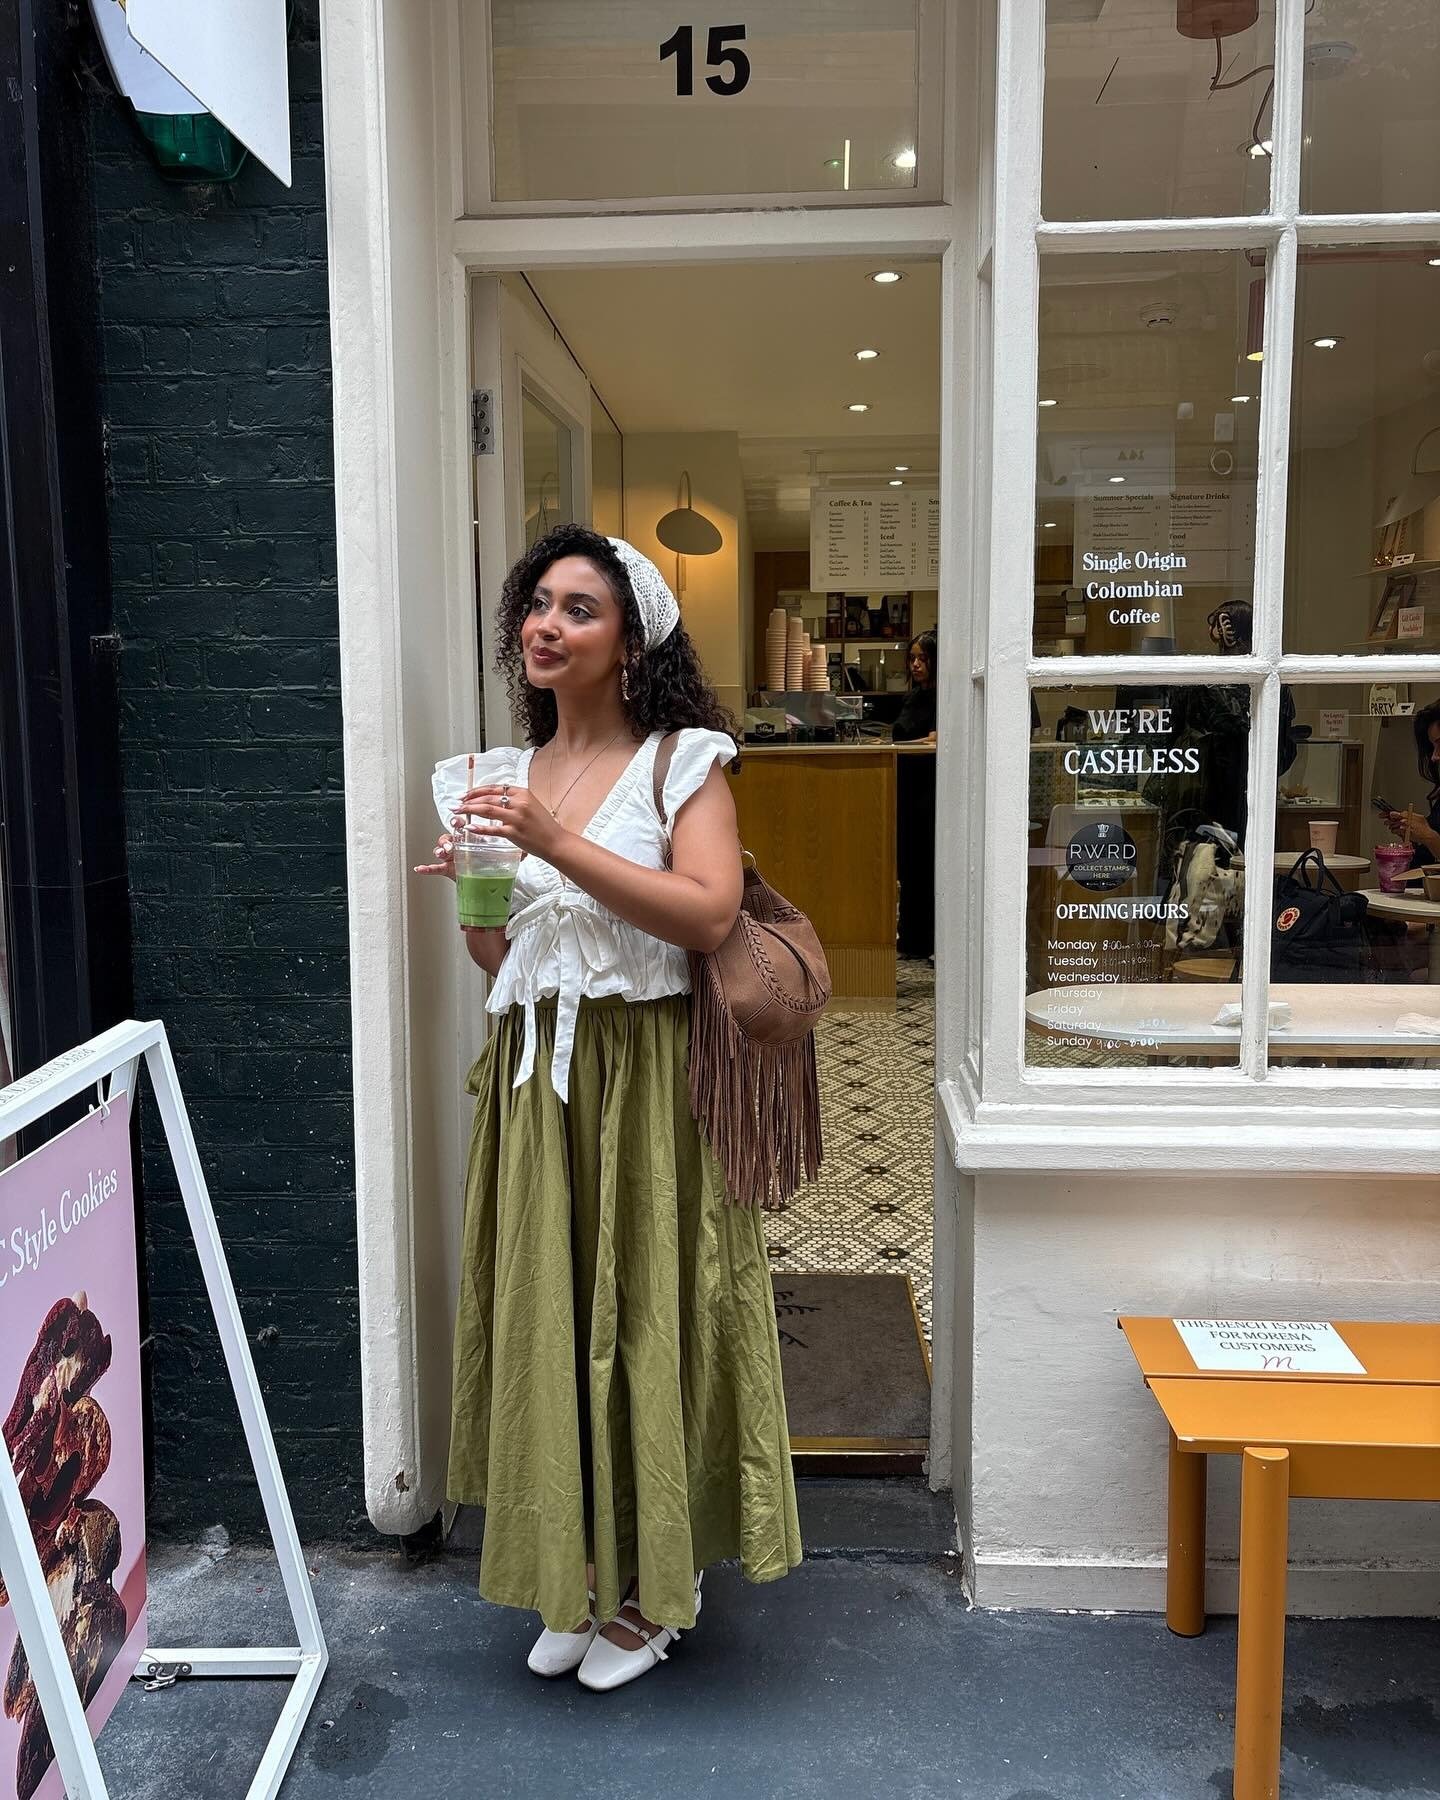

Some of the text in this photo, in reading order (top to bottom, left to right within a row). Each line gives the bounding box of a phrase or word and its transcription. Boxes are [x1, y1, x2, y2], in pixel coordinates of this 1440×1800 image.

[659, 24, 751, 96] 15
[828, 499, 852, 507] Coffee
[1083, 552, 1132, 574] Single
[1134, 550, 1188, 571] Origin
[1086, 580, 1184, 599] Colombian
[1109, 609, 1161, 624] Coffee
[1371, 702, 1395, 715] PARTY
[1088, 709, 1173, 734] WE'RE
[1064, 749, 1200, 774] CASHLESS
[1070, 843, 1136, 859] RWRD
[1056, 903, 1189, 919] OPENING HOURS
[1047, 939, 1097, 952] Monday
[1047, 955, 1099, 968] Tuesday
[1047, 971, 1120, 984] Wednesday
[1047, 987, 1103, 1000] Thursday
[1047, 1003, 1084, 1016] Friday
[1047, 1019, 1102, 1032] Saturday
[1047, 1035, 1093, 1048] Sunday
[10, 1207, 57, 1276] Style
[60, 1169, 118, 1234] Cookies
[1177, 1320, 1329, 1331] THIS BENCH IS ONLY
[1210, 1331, 1313, 1341] FOR MORENA
[1220, 1341, 1317, 1352] CUSTOMERS
